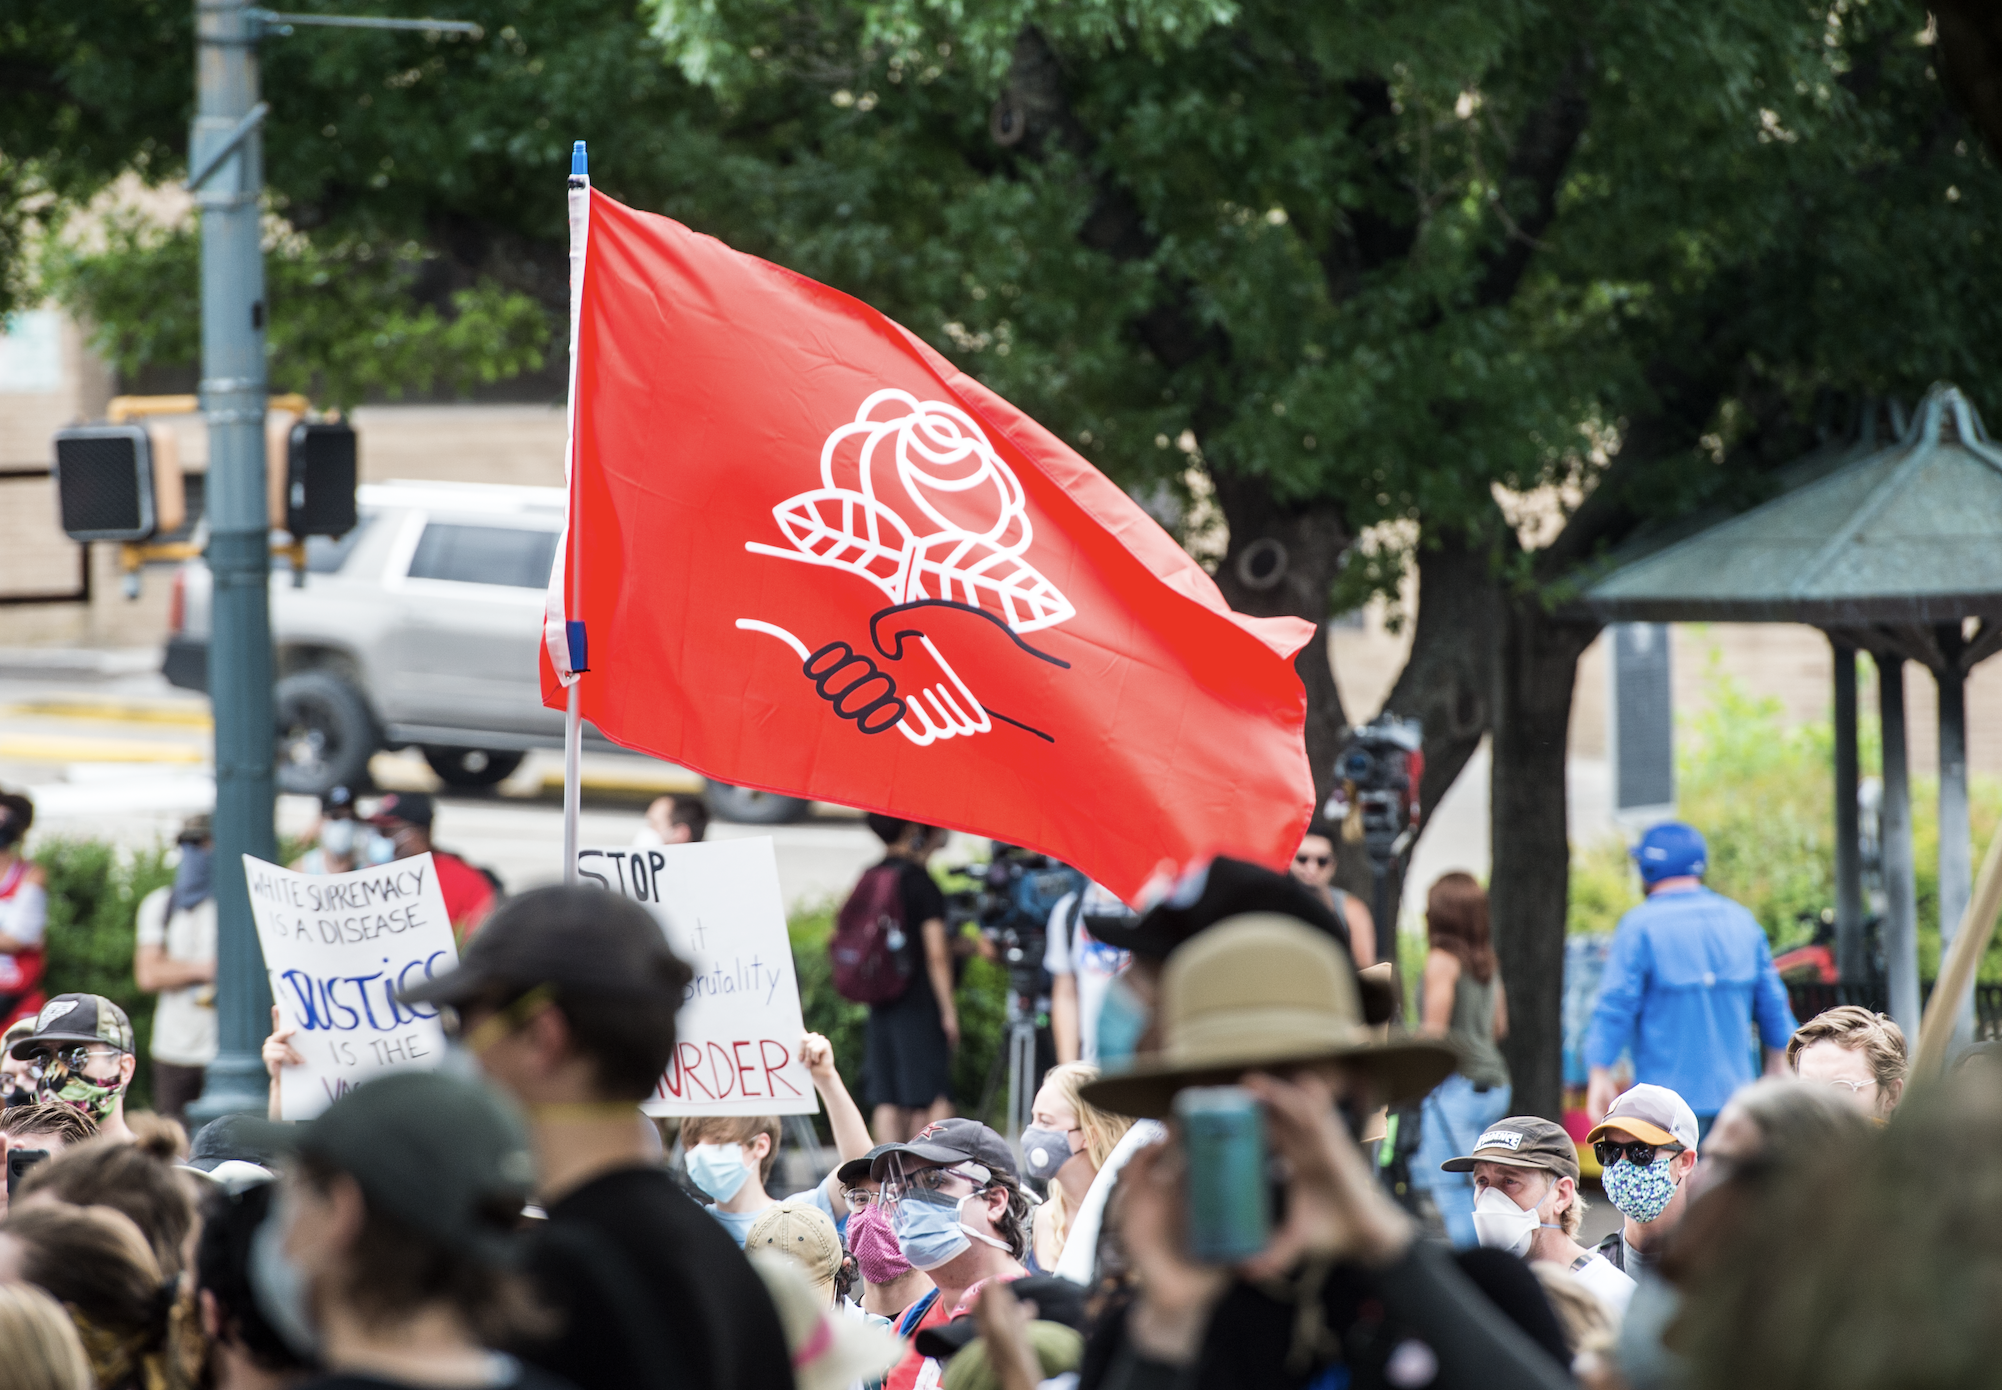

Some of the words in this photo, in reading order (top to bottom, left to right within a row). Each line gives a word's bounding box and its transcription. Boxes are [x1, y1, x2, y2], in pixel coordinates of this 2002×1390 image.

[250, 868, 304, 908] WHITE
[307, 864, 425, 912] SUPREMACY
[578, 850, 666, 903] STOP
[269, 911, 288, 936] IS
[296, 918, 313, 943] A
[318, 903, 427, 945] DISEASE
[329, 1040, 357, 1066] IS
[369, 1034, 430, 1066] THE
[656, 1039, 803, 1100] URDER
